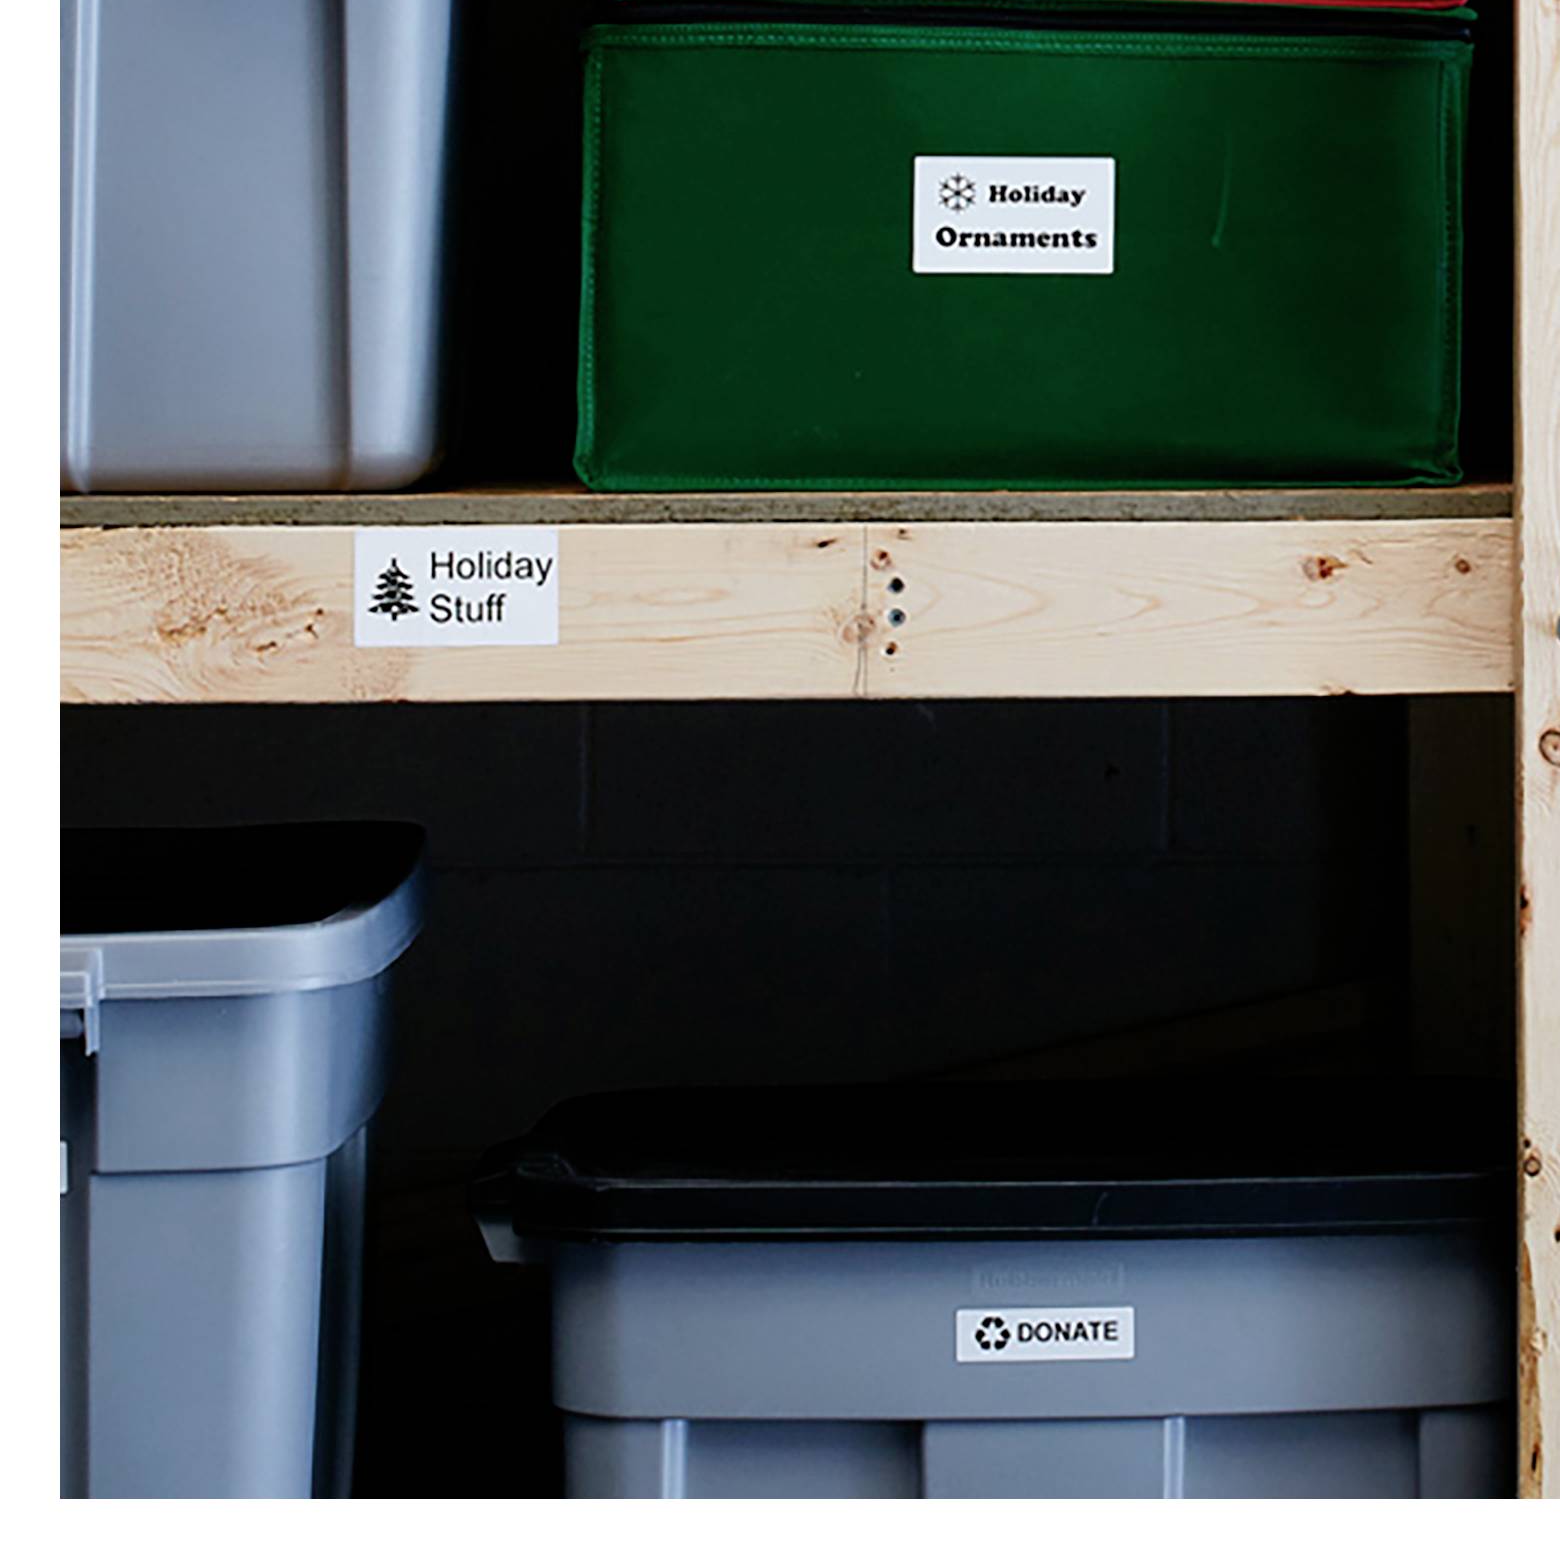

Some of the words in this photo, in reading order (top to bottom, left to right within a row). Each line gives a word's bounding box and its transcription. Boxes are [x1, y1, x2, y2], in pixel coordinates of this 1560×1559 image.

[988, 184, 1086, 208] Holiday
[935, 226, 1097, 249] Ornaments
[431, 550, 553, 585] Holiday
[429, 593, 506, 624] Stuff
[1017, 1320, 1119, 1343] DONATE
